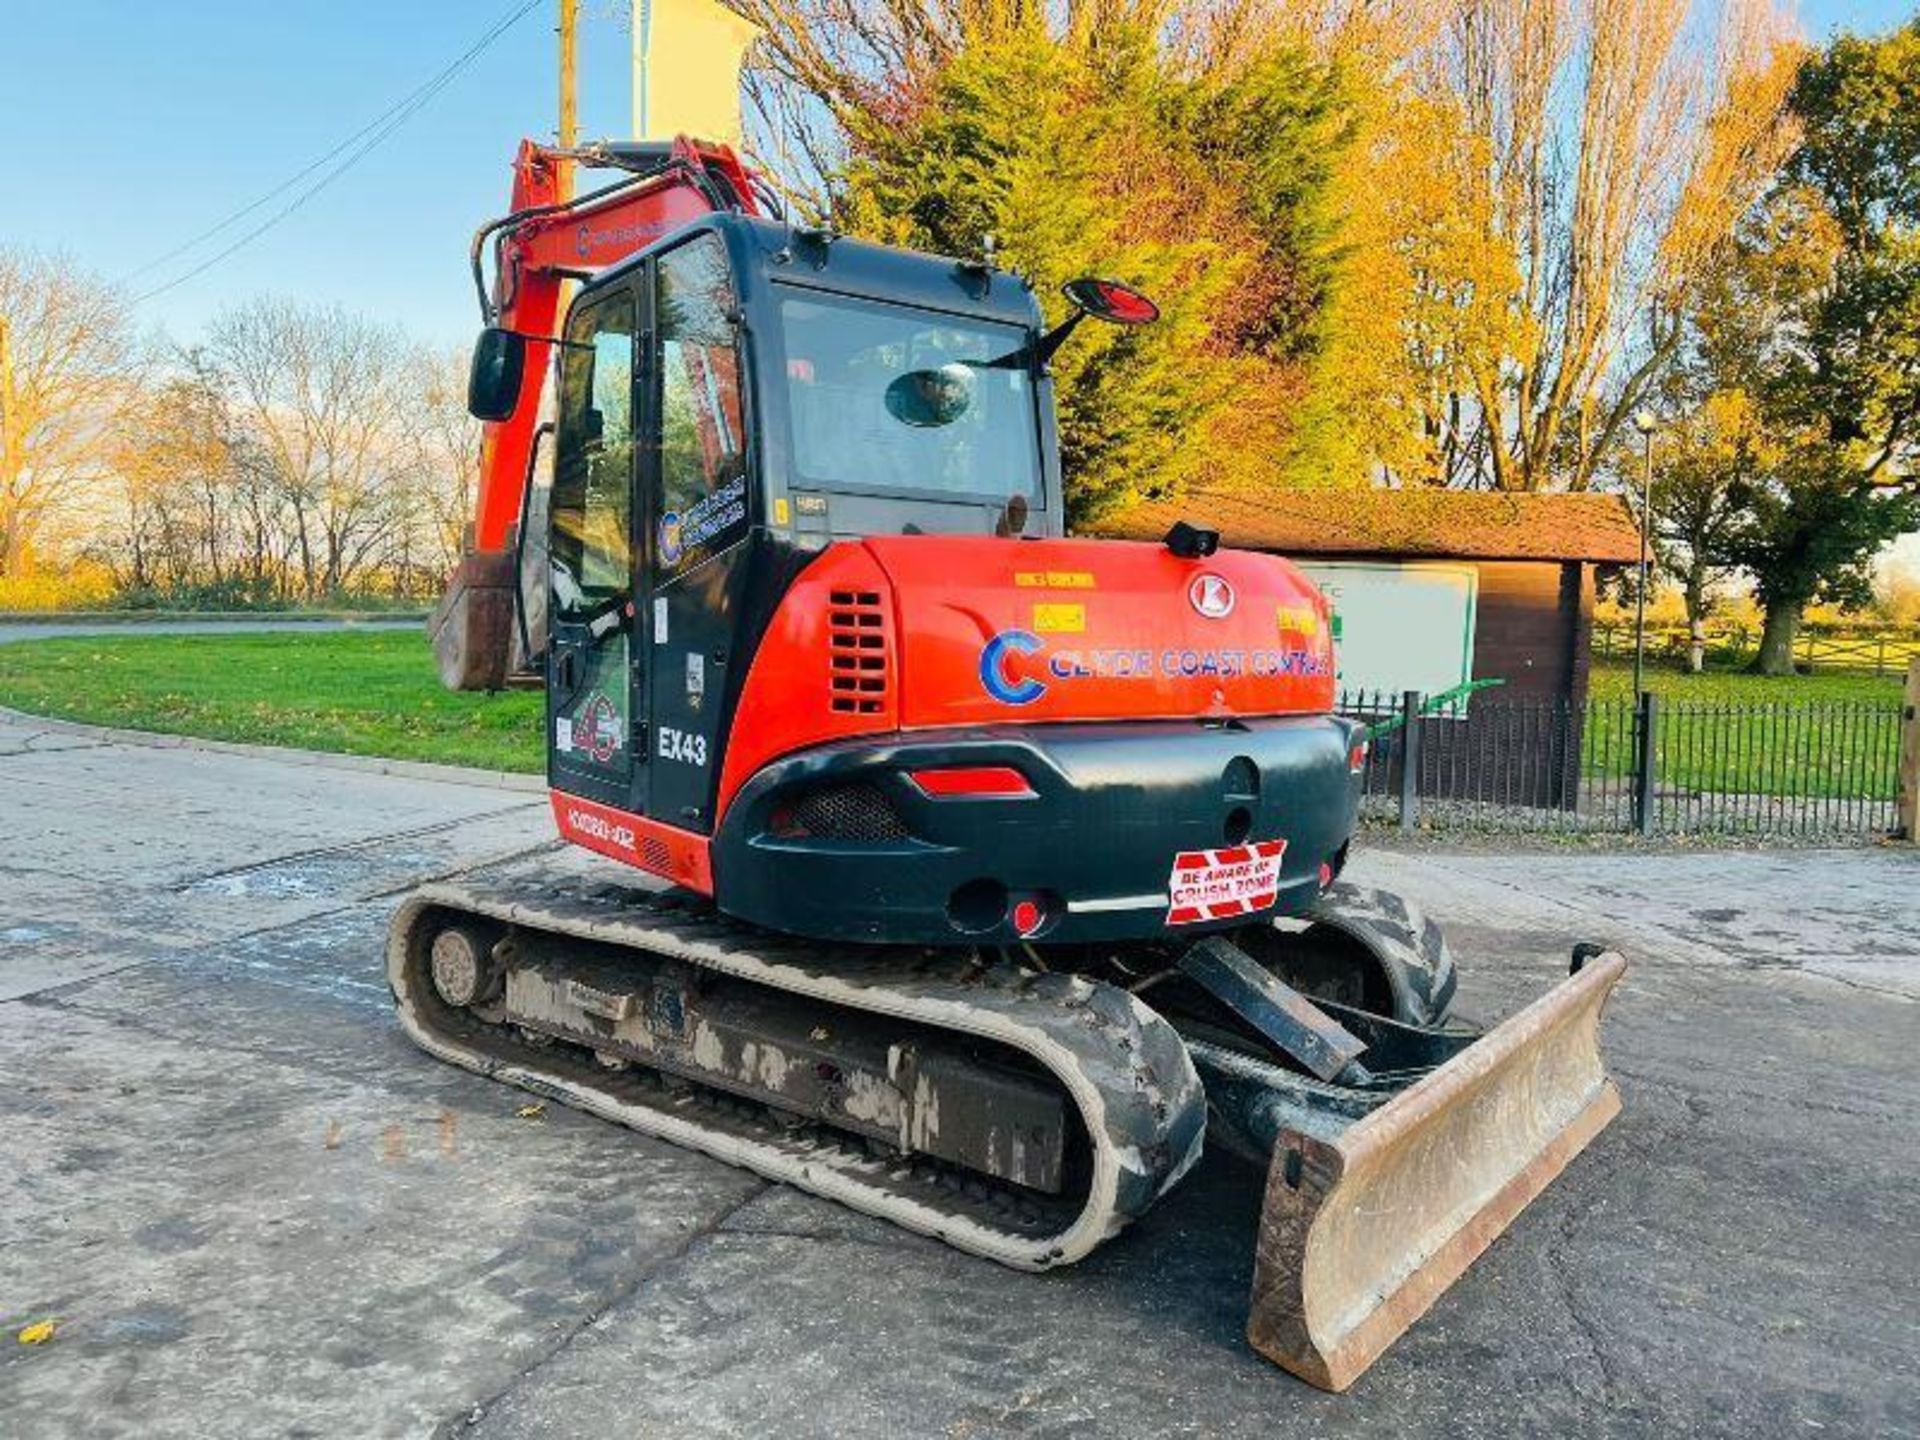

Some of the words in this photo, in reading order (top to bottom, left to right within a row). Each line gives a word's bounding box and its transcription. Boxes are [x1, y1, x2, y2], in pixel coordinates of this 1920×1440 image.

[1048, 648, 1151, 678] CLYDE
[1160, 649, 1244, 677] COAST
[658, 726, 707, 767] EX43
[1173, 883, 1232, 905] CRUSH
[1236, 873, 1276, 896] ZONE
[1181, 870, 1201, 884] BE
[1204, 864, 1251, 883] AWARE
